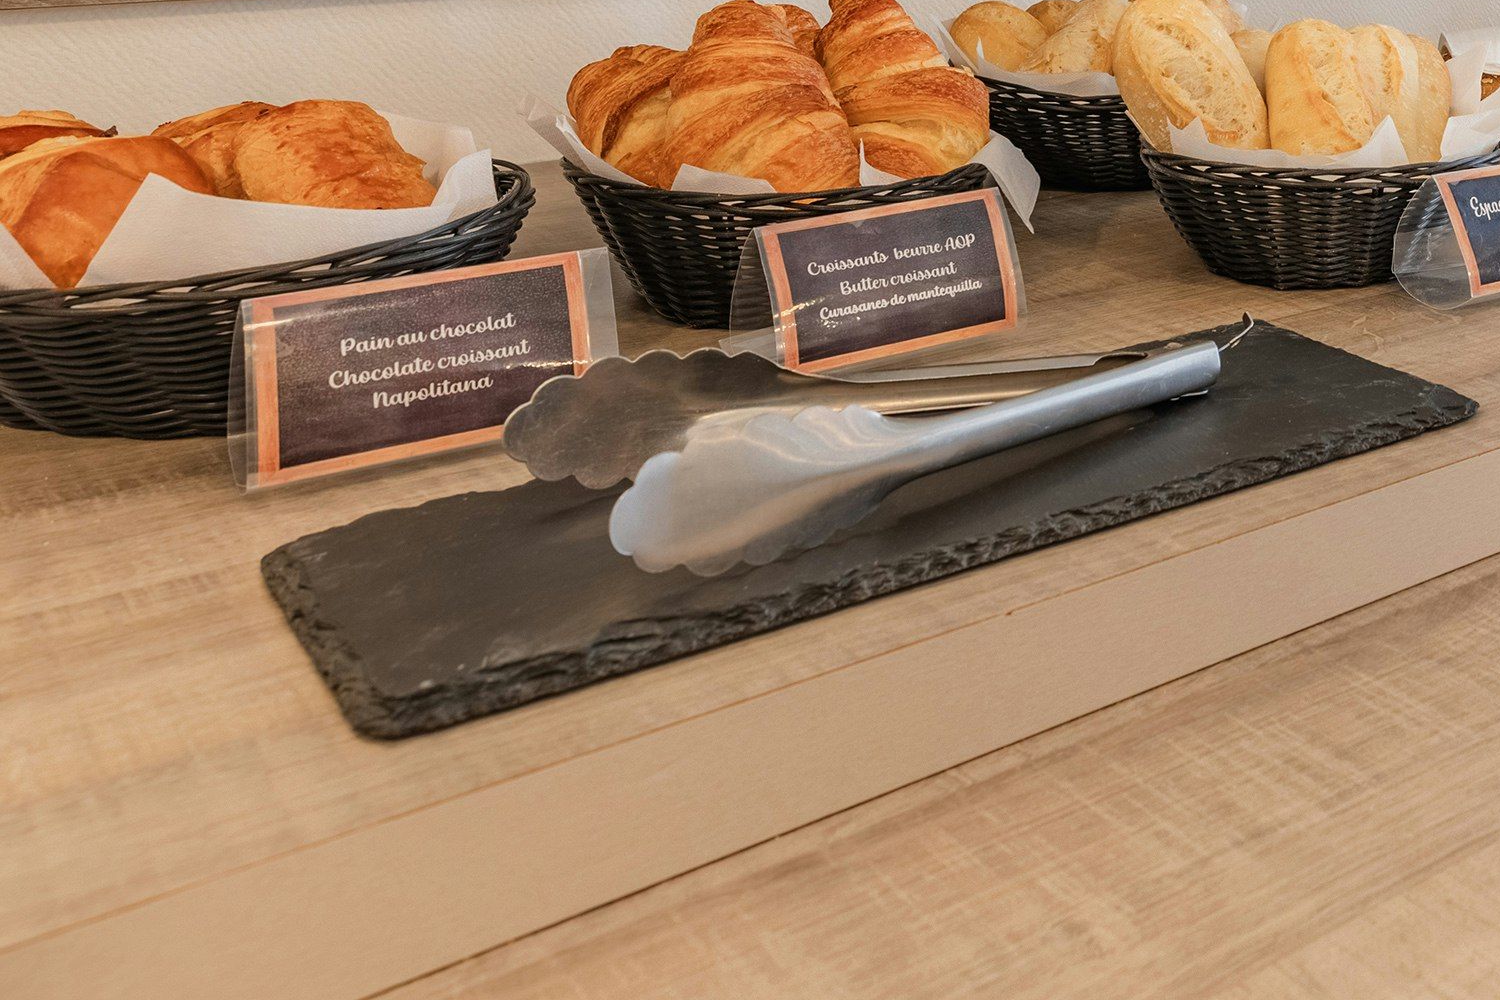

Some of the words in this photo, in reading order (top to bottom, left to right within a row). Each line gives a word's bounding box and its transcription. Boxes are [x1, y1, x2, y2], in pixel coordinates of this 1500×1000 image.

[807, 249, 890, 277] Croissants
[893, 244, 943, 261] beurre
[944, 232, 976, 252] AOP
[819, 297, 890, 321] Curasanes
[890, 291, 907, 307] de
[907, 278, 983, 303] mantequilla
[839, 276, 890, 297] Butter
[890, 261, 957, 286] croissant
[339, 334, 394, 357] Pain
[396, 330, 428, 347] au
[429, 311, 518, 341] chocolat
[327, 356, 435, 390] Chocolate
[436, 338, 531, 369] croissant
[372, 374, 494, 410] Napolitana
